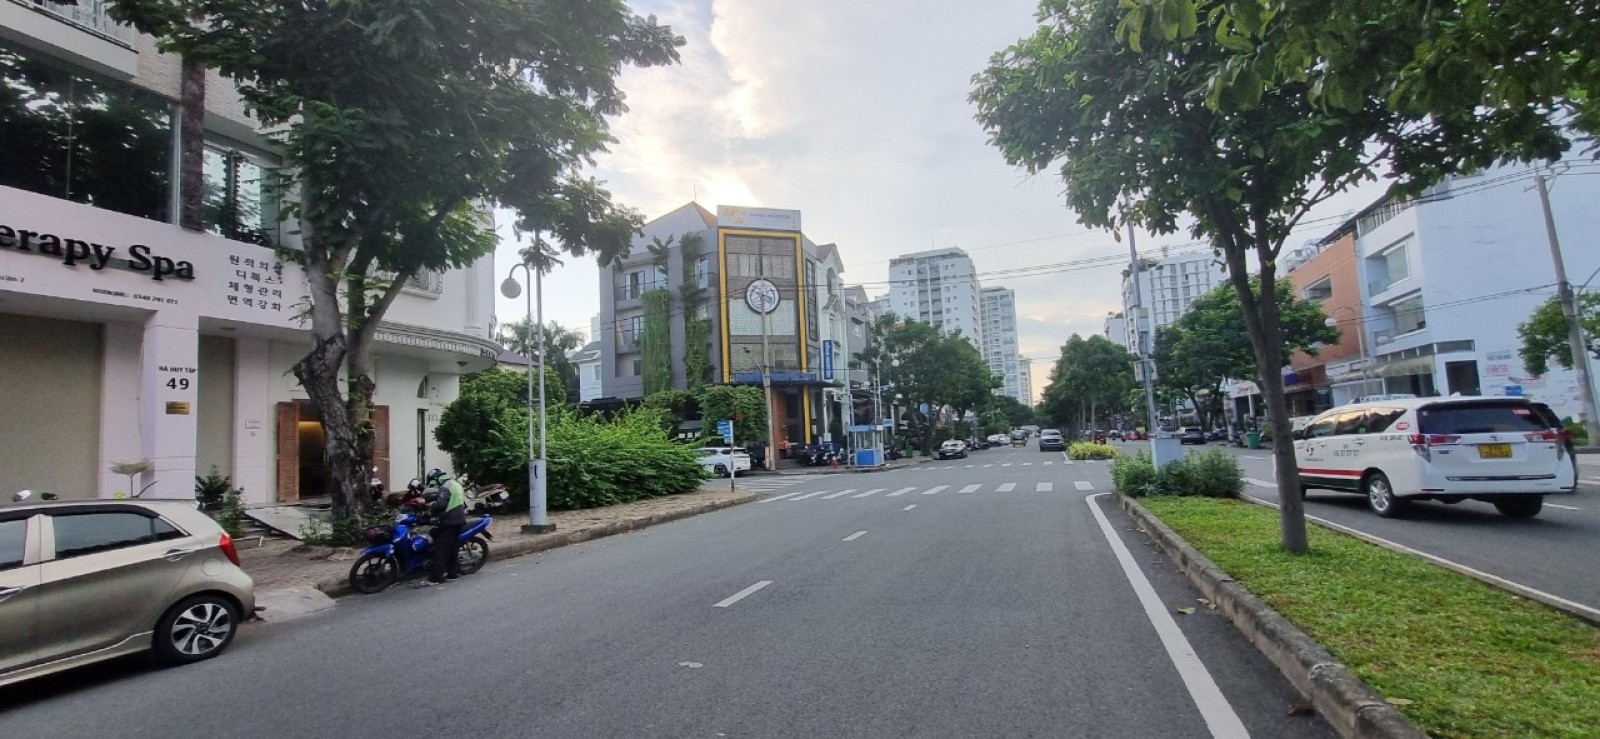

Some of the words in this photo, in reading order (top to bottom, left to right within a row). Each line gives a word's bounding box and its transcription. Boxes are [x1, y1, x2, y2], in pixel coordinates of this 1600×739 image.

[128, 244, 196, 281] Spa
[227, 295, 282, 312] 면역강화
[165, 377, 190, 390] 49
